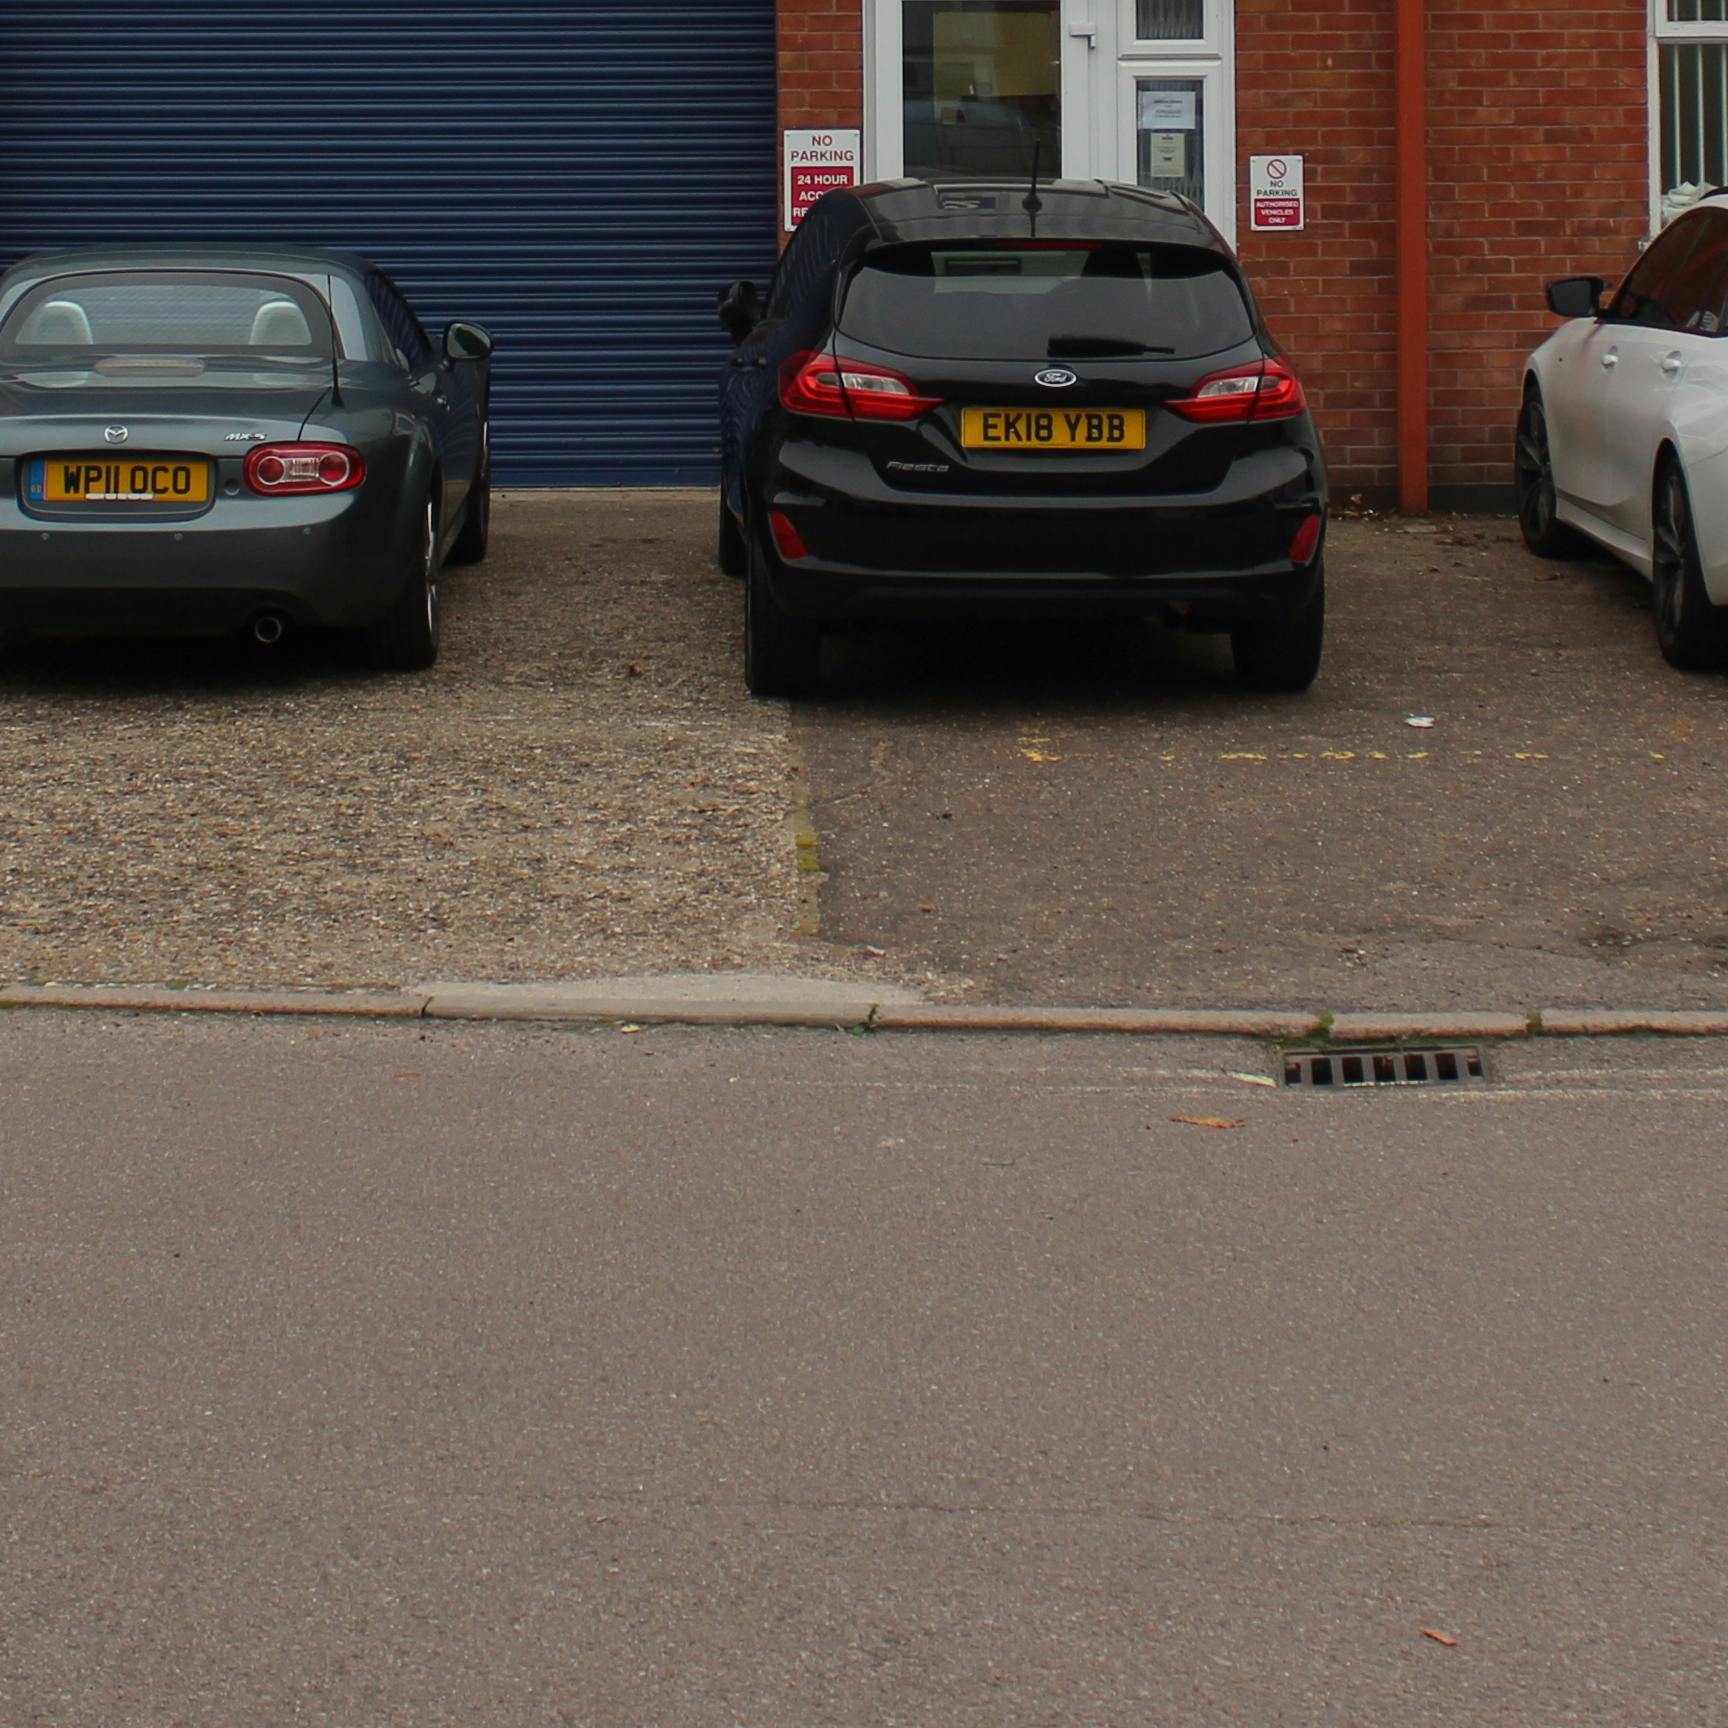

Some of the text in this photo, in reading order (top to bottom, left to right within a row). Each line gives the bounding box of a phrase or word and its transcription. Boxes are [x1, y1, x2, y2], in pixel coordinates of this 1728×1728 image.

[812, 135, 833, 146] NO
[791, 150, 854, 161] PARKING
[797, 175, 848, 185] 24 HOUR
[1270, 180, 1284, 188] NO
[1256, 189, 1297, 197] PARKING
[1043, 371, 1068, 384] Ford
[982, 413, 1125, 443] EK18 YBB
[887, 461, 950, 472] Fiesta
[63, 465, 192, 495] WP11 OCO
